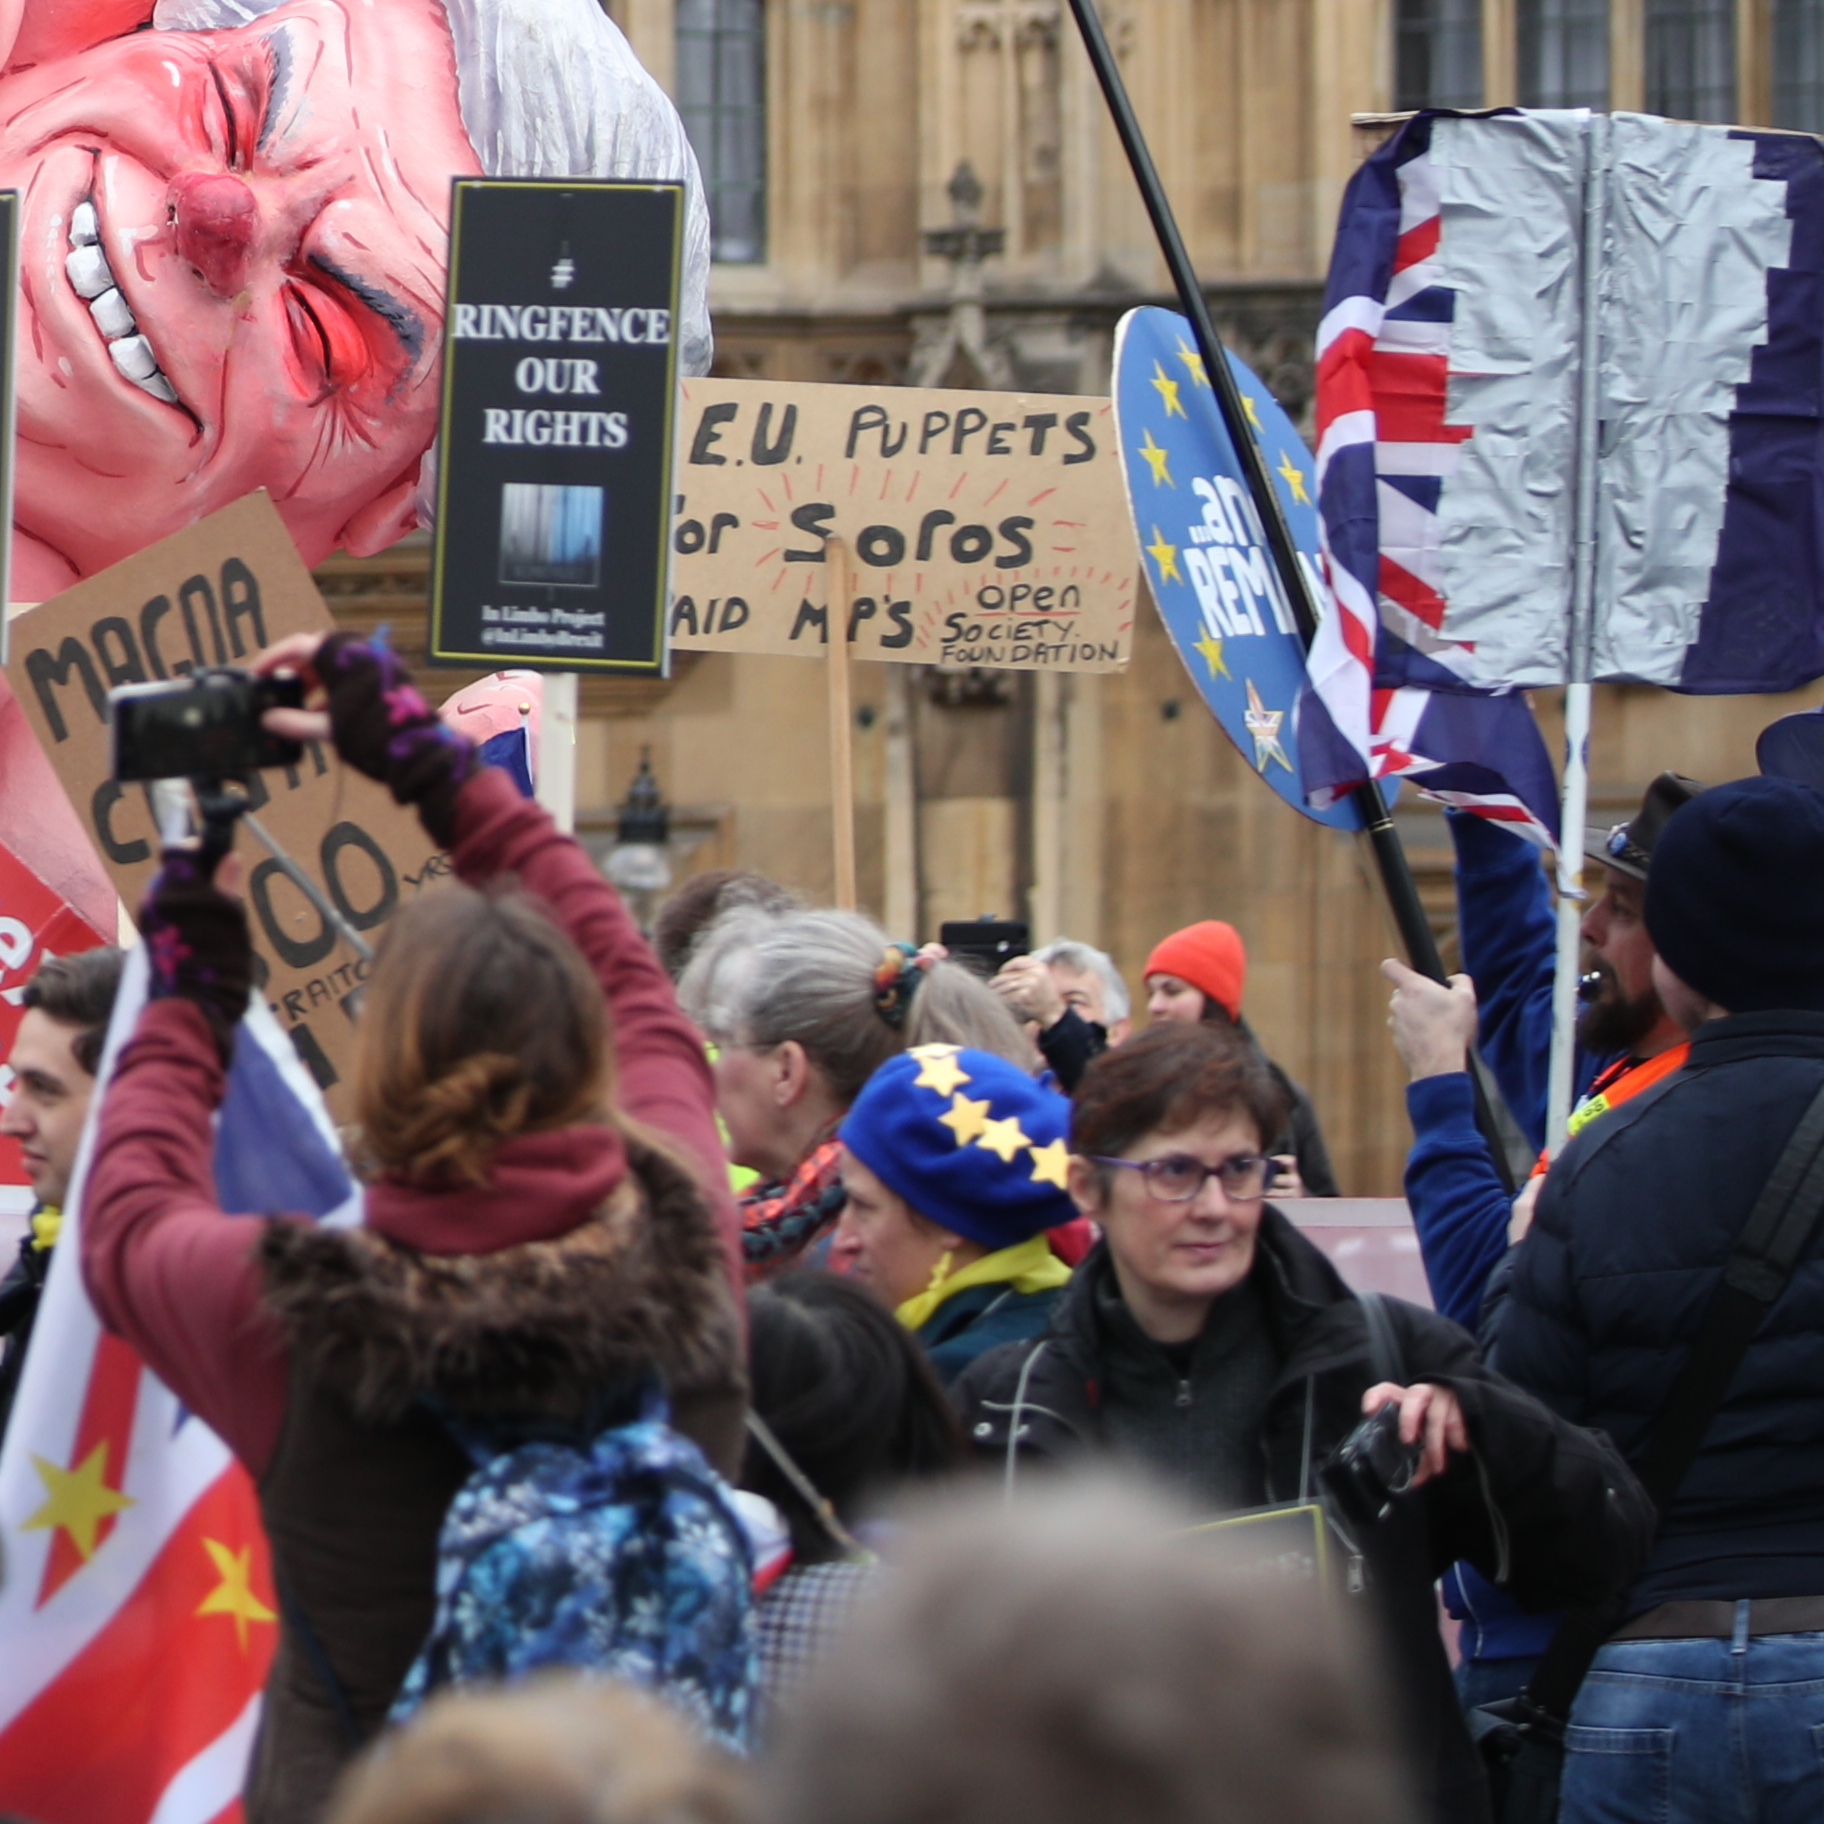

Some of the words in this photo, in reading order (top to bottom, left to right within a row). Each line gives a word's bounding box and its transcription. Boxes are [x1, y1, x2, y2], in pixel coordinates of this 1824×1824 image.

[550, 258, 575, 288] #
[451, 303, 670, 344] RINGFENCE
[515, 357, 601, 395] OUR
[482, 408, 629, 449] RIGHTS
[688, 402, 802, 467] E.U.
[845, 405, 1096, 465] PUPPETS
[674, 494, 740, 555] or
[783, 502, 1034, 569] Soros
[670, 594, 750, 637] AID
[25, 557, 267, 743] MAGNA
